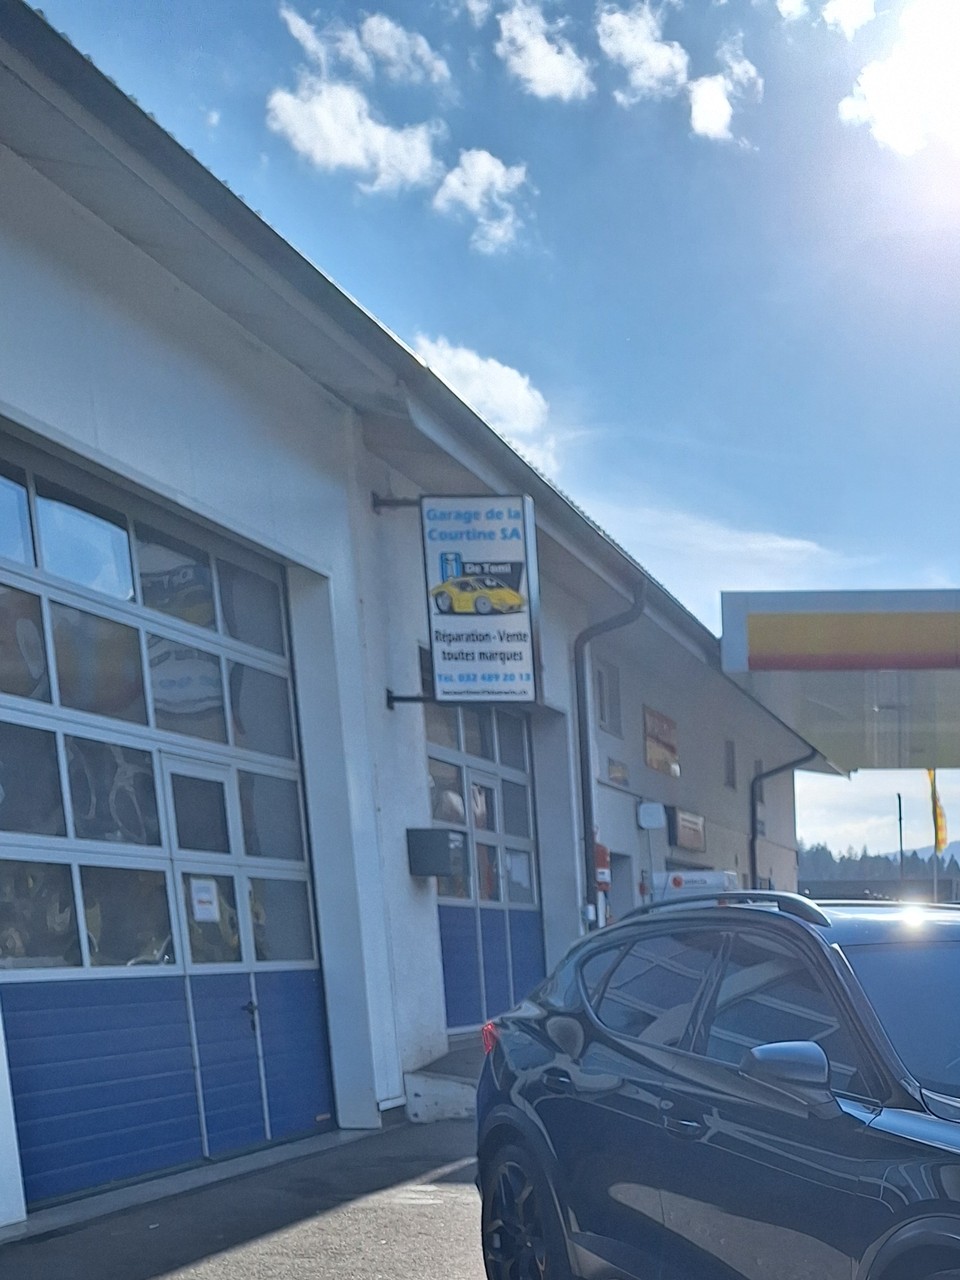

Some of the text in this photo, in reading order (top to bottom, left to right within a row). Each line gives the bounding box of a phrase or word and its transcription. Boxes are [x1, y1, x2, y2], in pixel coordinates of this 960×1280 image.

[426, 508, 520, 524] Garage de la
[428, 528, 521, 540] Courtine SA
[435, 630, 491, 646] Réparation
[498, 630, 528, 643] Vente
[442, 650, 524, 665] toutes marques
[458, 673, 477, 682] 032
[503, 673, 516, 682] 20
[520, 673, 531, 682] 13
